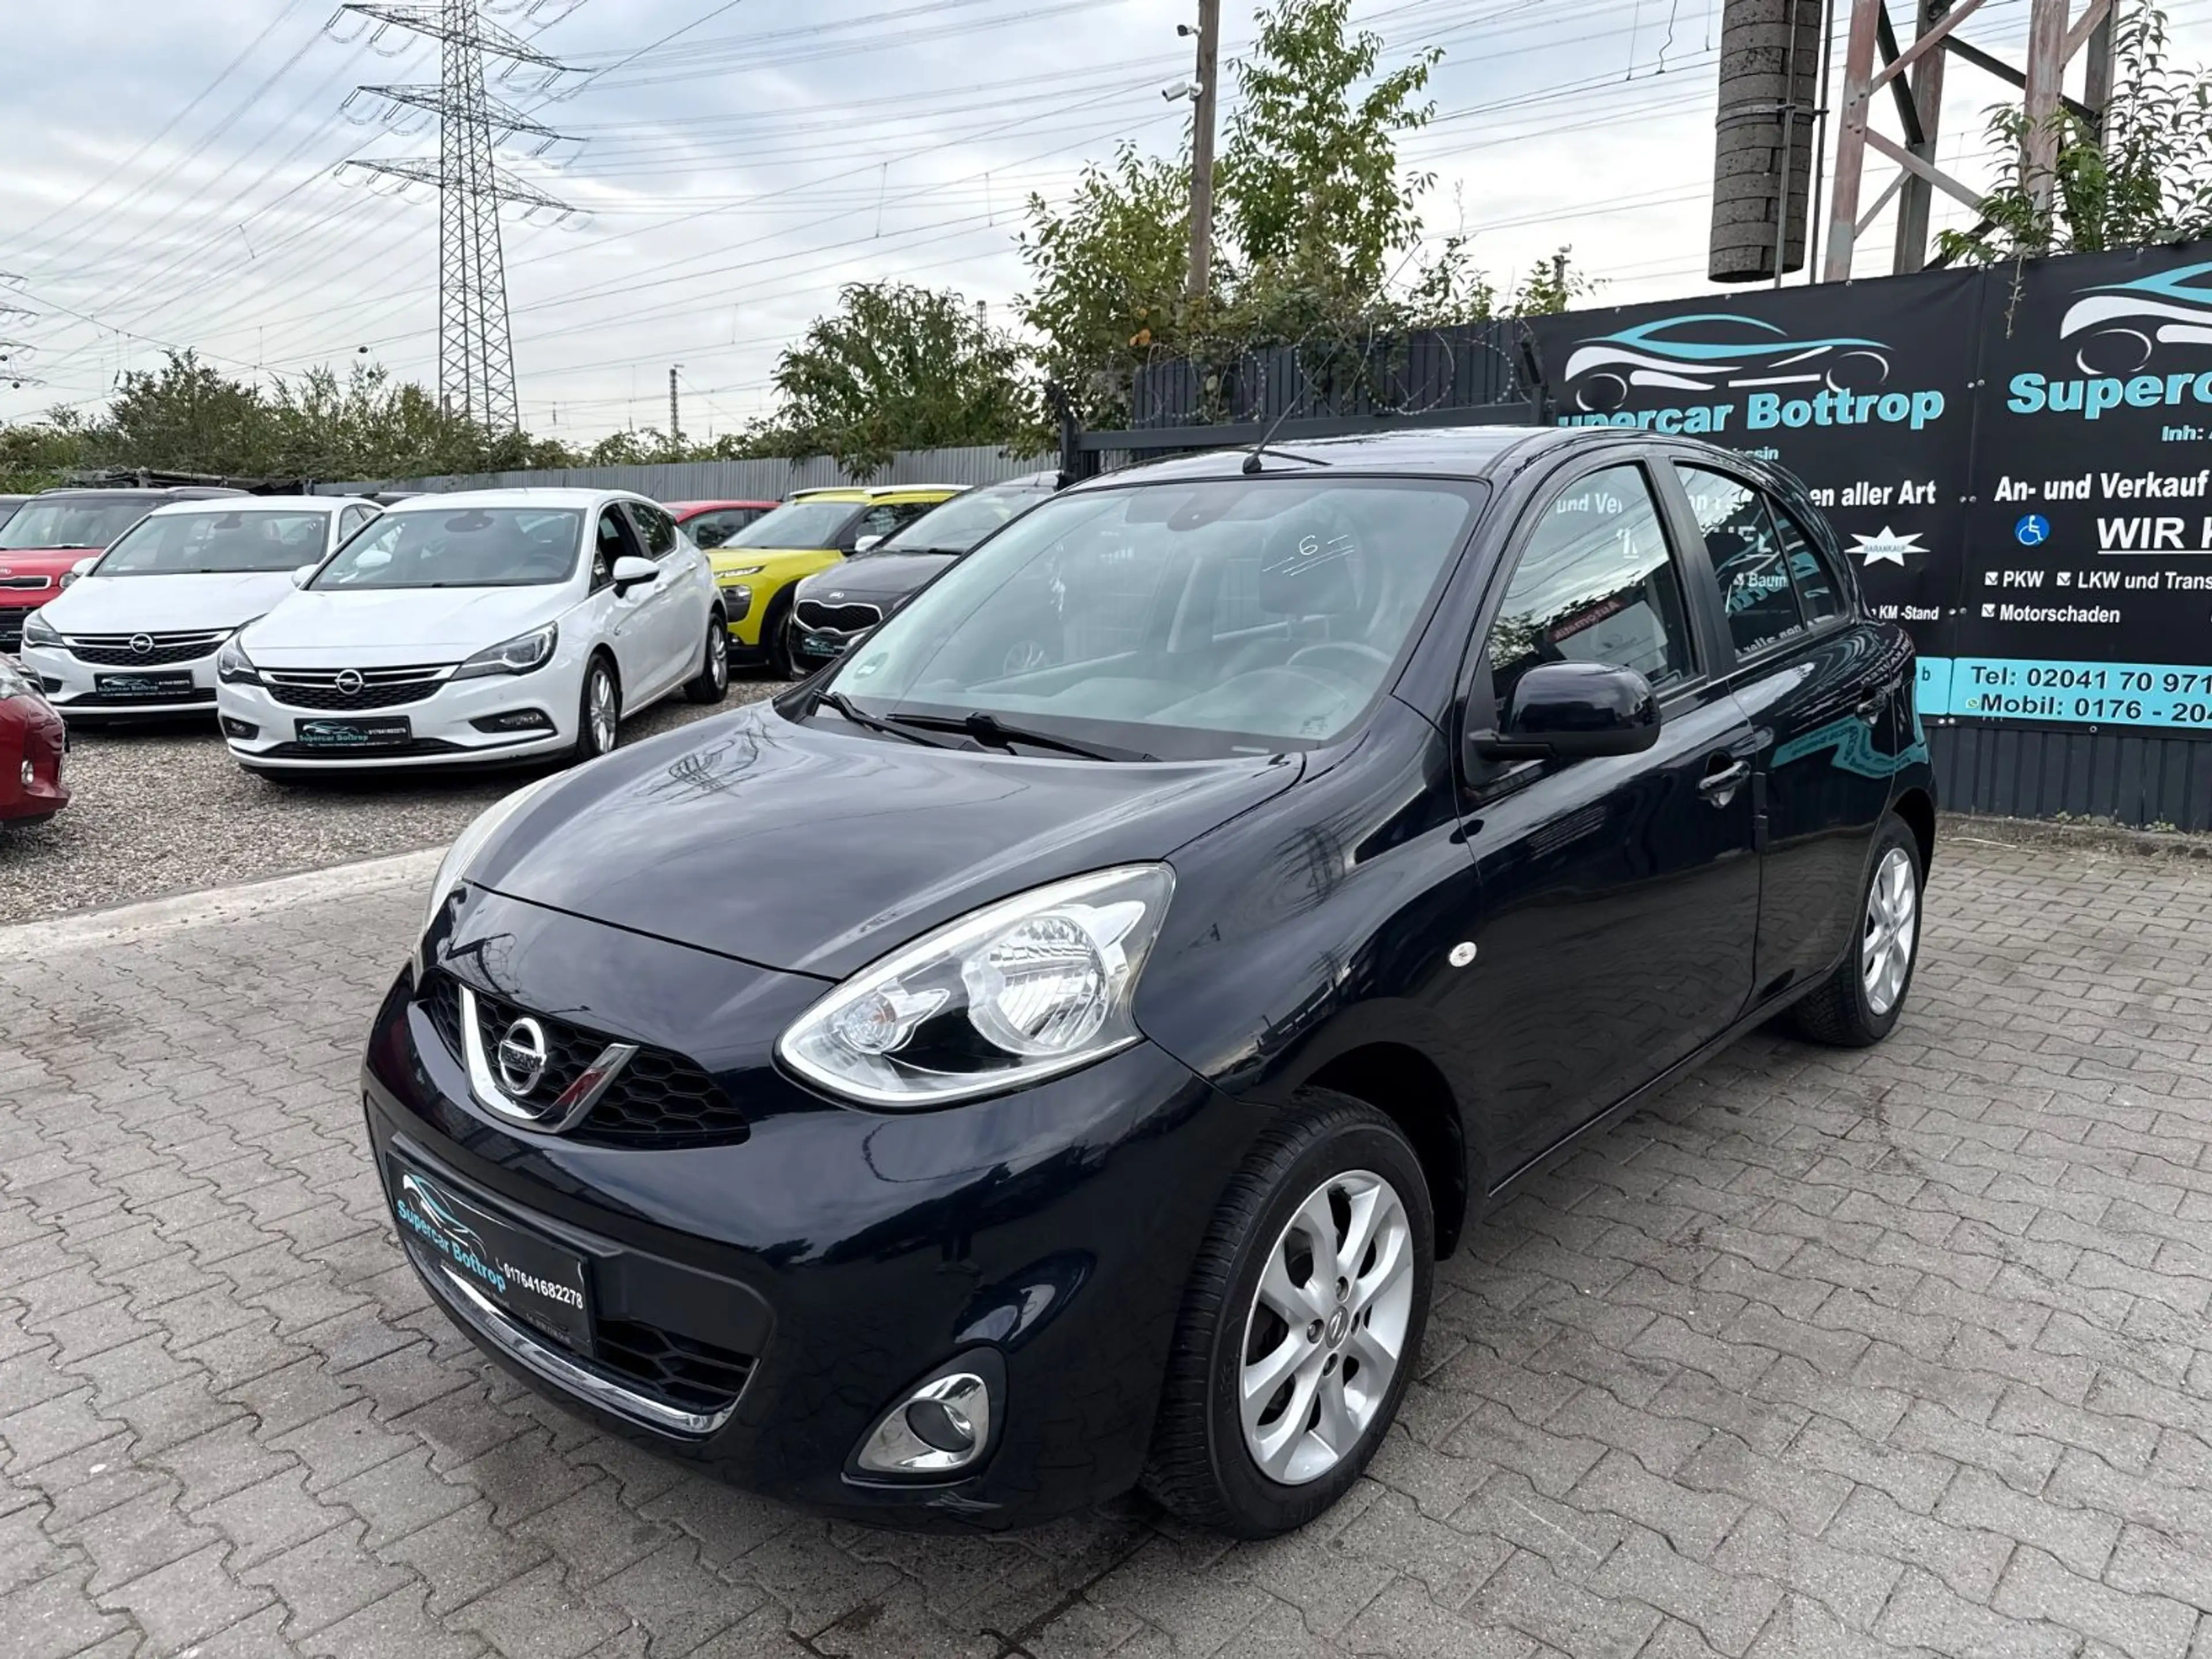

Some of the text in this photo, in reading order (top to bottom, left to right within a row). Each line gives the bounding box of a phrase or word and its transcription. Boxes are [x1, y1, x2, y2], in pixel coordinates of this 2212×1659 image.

[1747, 389, 1944, 430] Bottrop
[2162, 425, 2204, 442] Inh:
[1841, 482, 1893, 506] aller
[1898, 480, 1937, 505] Art
[1994, 469, 2210, 501] An- und Verkauf
[2097, 517, 2185, 550] WIR
[2003, 571, 2044, 588] PKW
[2077, 571, 2121, 589] LKW
[2125, 571, 2159, 589] und
[1878, 605, 1898, 619] KM
[1999, 604, 2121, 623] Motorschaden
[1971, 666, 2017, 685] Tel:
[2027, 668, 2107, 690] 02041
[2120, 672, 2153, 692] 70
[1981, 694, 2063, 715] Mobil:
[2075, 697, 2142, 719] 0176
[397, 1200, 450, 1253] Supercar
[452, 1242, 506, 1293] Bottrop
[503, 1263, 584, 1310] 017641682278
